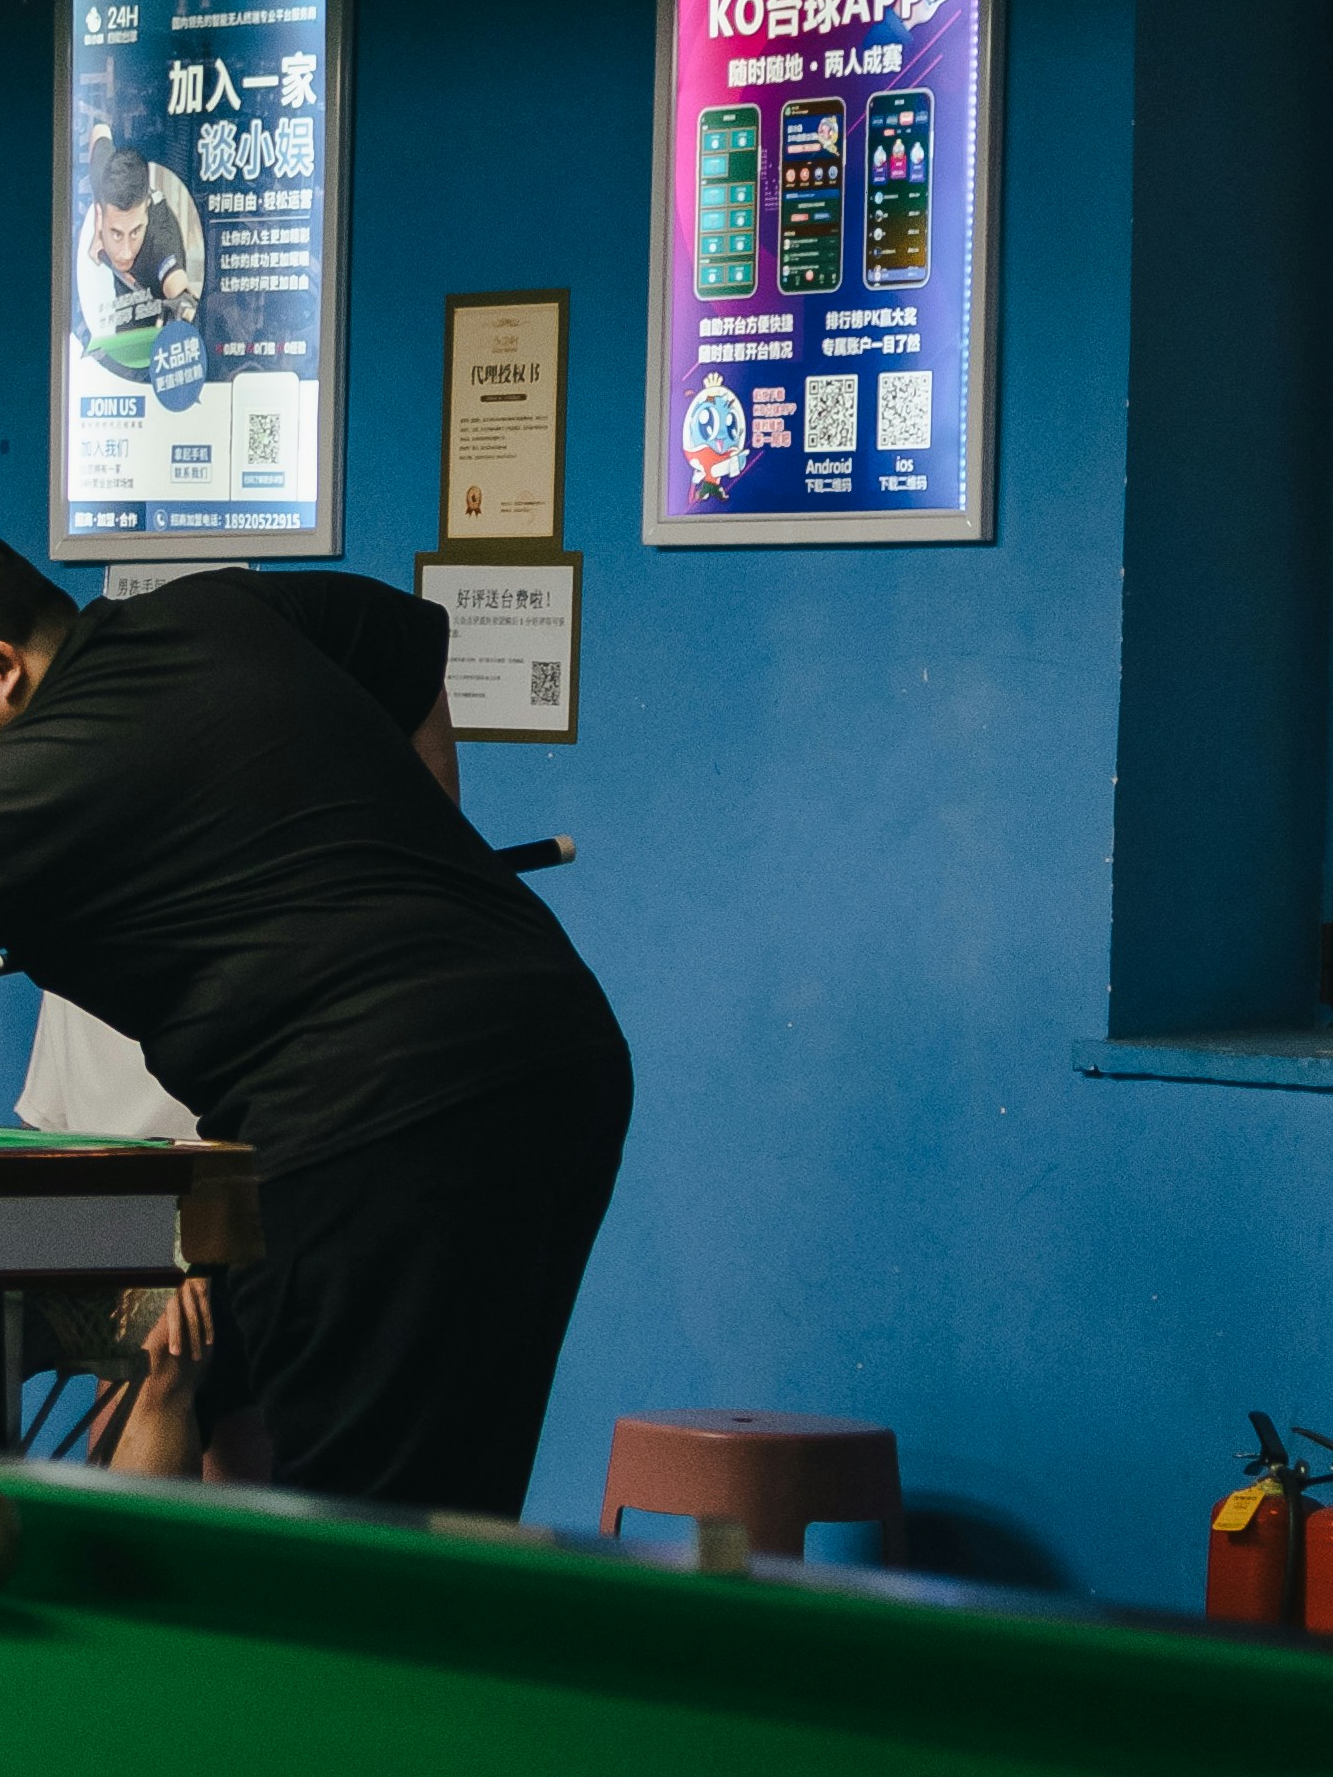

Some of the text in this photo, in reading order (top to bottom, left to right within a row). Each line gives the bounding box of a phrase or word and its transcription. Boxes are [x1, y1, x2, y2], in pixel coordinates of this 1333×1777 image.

[107, 5, 139, 30] 24H
[167, 51, 317, 115] 加入一家
[197, 117, 315, 182] 谈小娱
[153, 336, 200, 373] 大品牌
[471, 362, 541, 385] 代理授权书
[87, 398, 137, 417] JOIN US
[805, 457, 853, 475] Android
[224, 512, 301, 529] 18920522915
